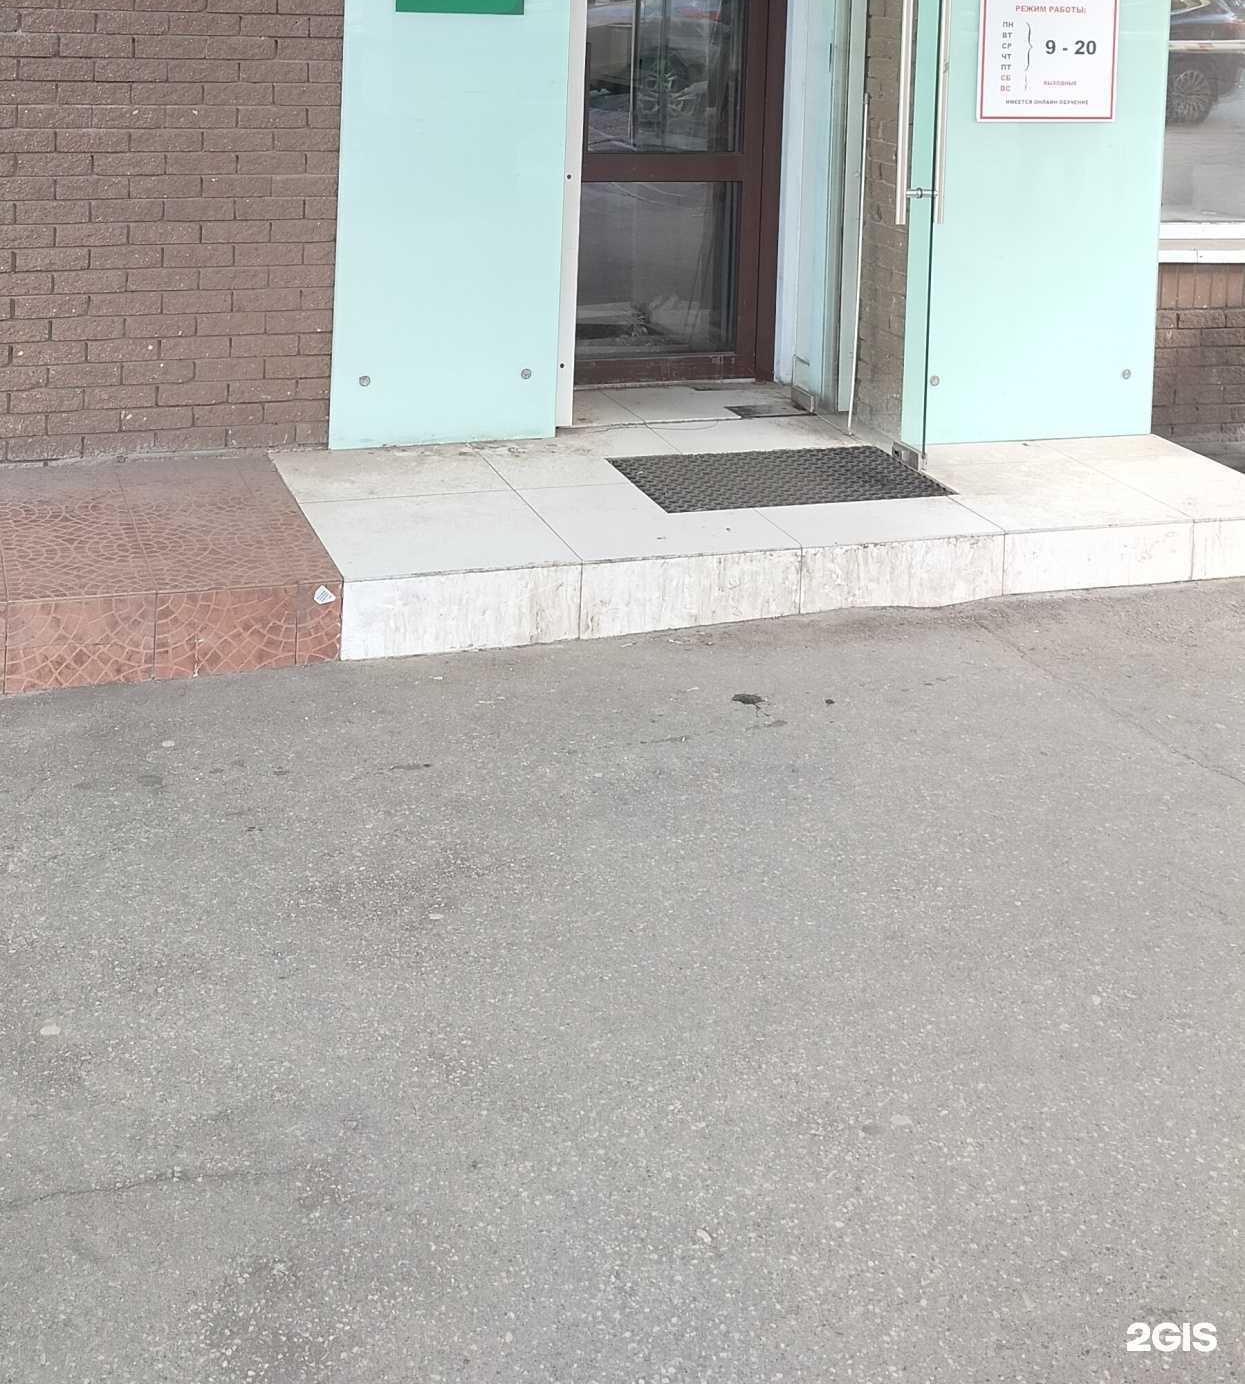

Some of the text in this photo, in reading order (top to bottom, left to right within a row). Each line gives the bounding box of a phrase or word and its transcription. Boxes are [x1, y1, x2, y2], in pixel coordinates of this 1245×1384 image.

[1016, 5, 1086, 14] РЕЖИМ РАБОТЫ:
[1045, 40, 1056, 55] 9
[1074, 40, 1097, 55] 20
